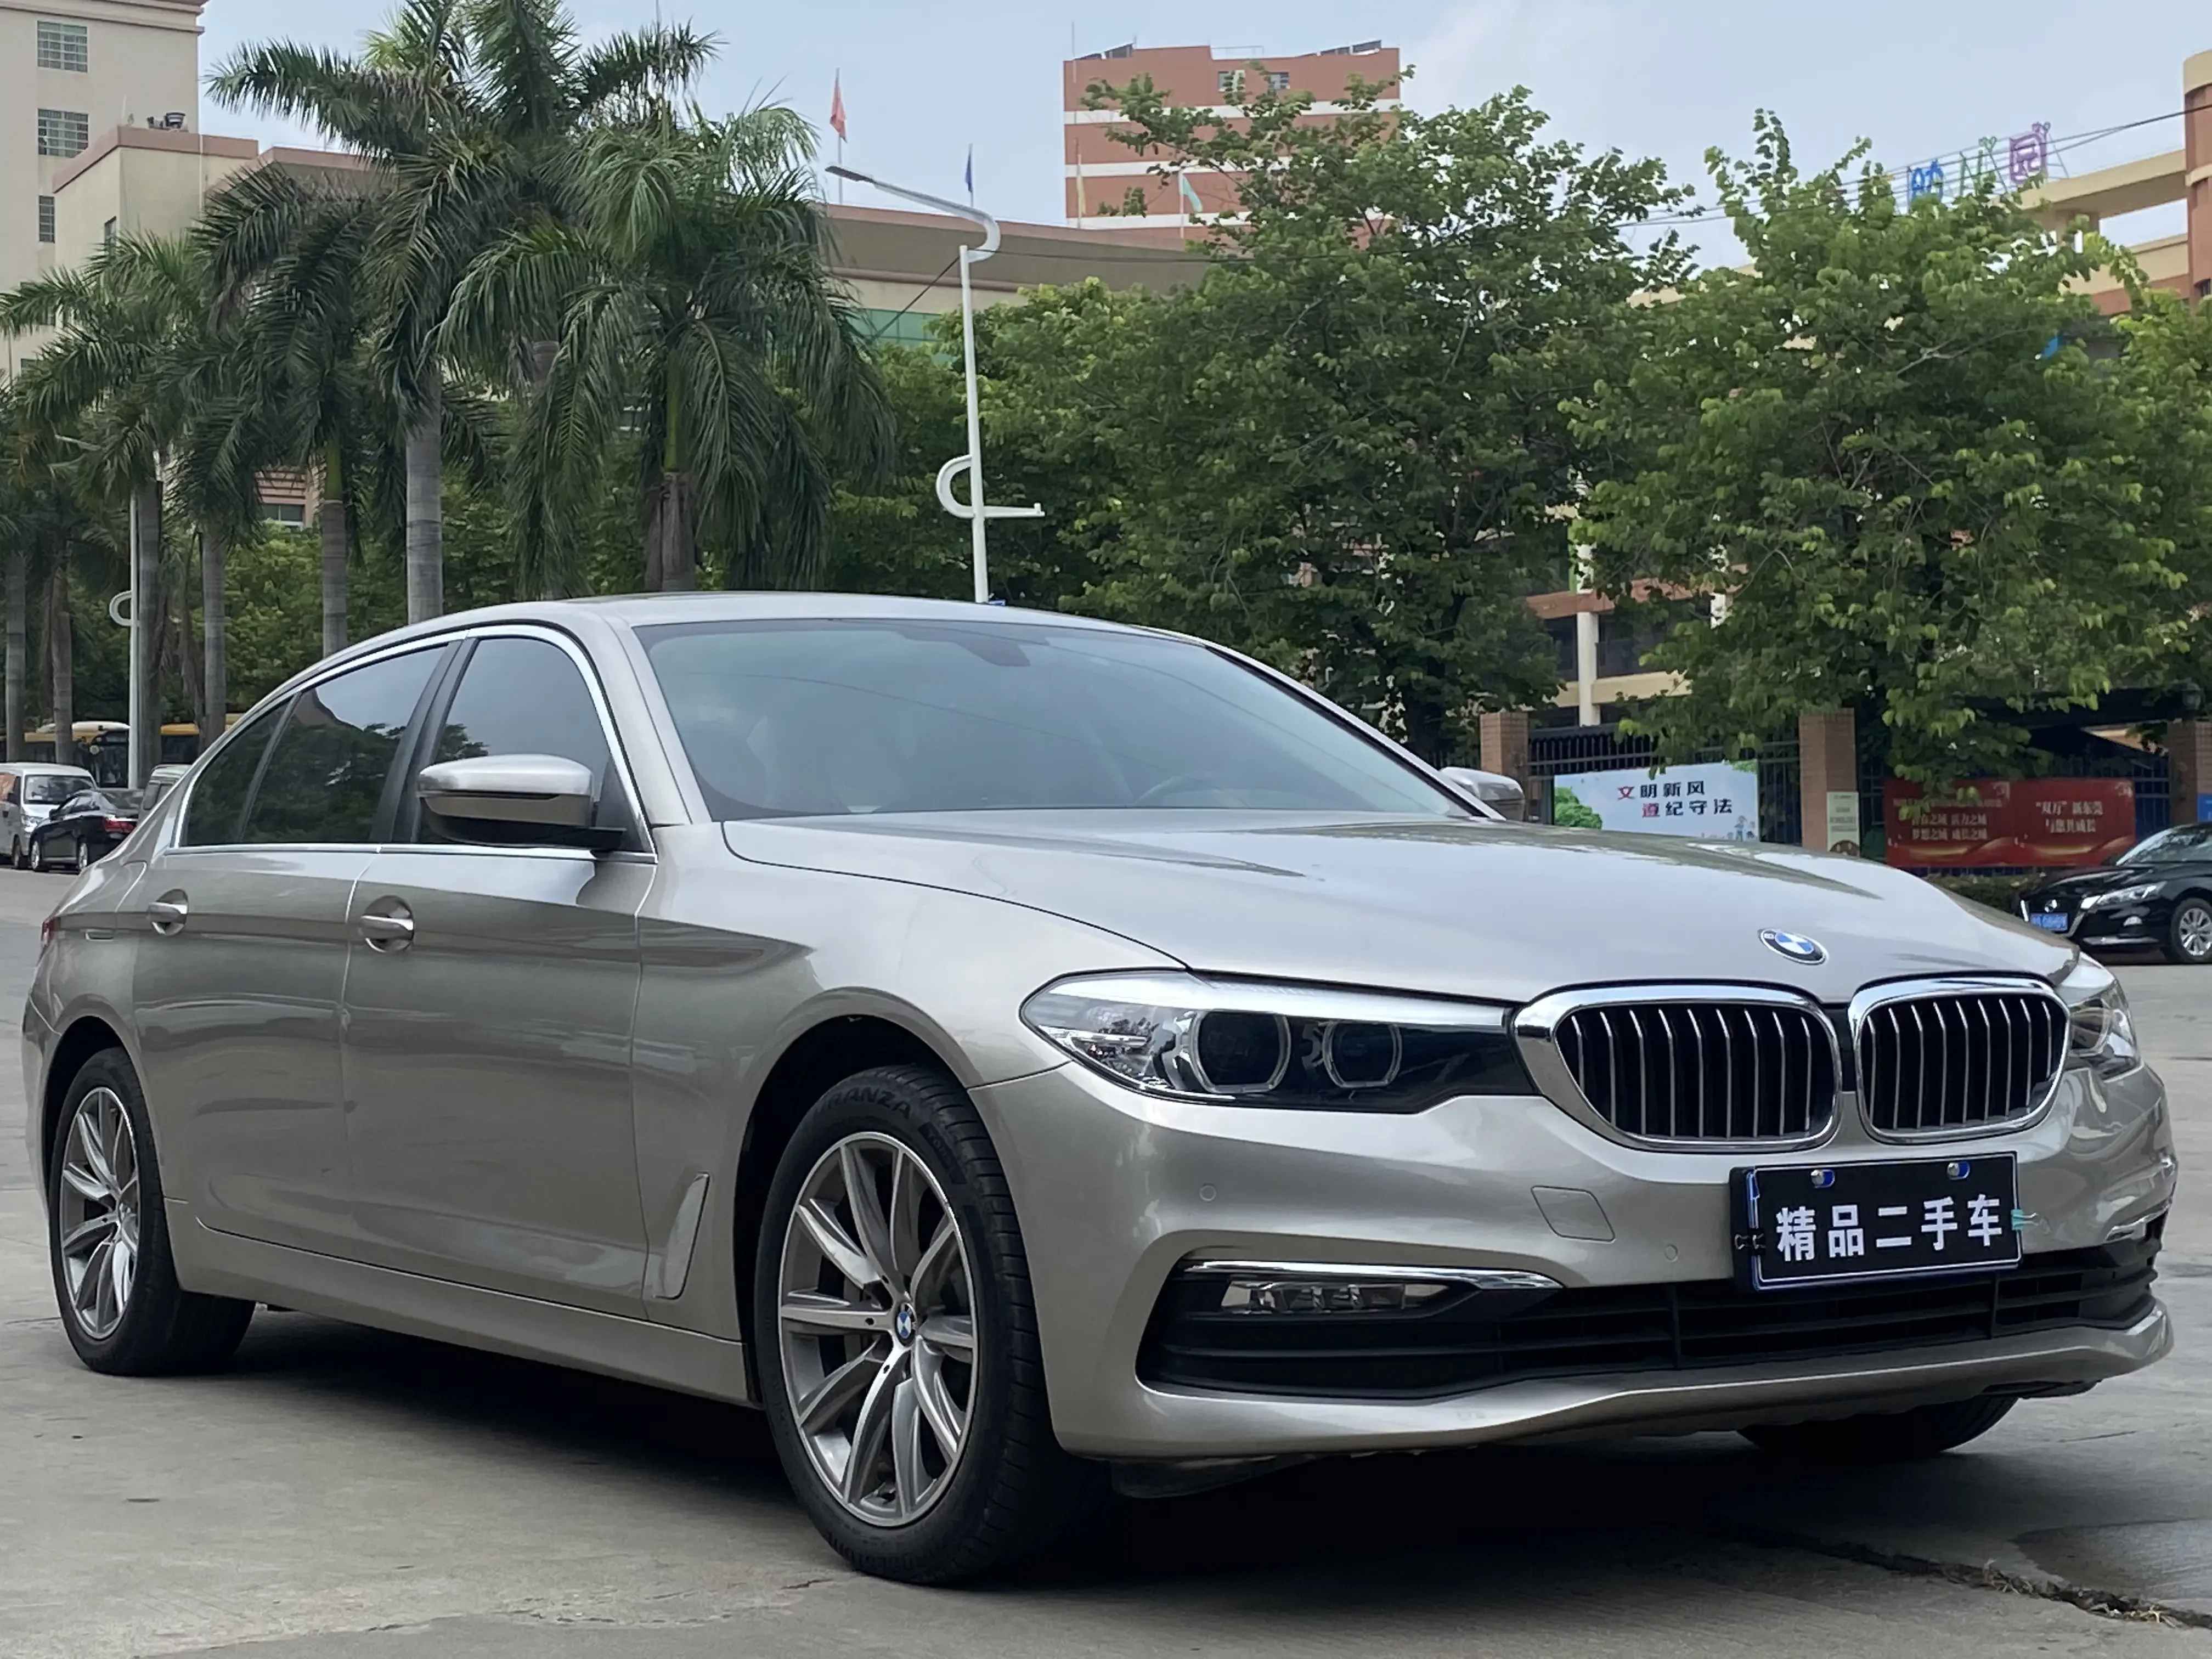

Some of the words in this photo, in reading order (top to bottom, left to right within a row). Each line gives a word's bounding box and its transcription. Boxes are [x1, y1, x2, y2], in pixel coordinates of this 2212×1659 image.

[1618, 781, 1705, 800] 文明新风
[1642, 799, 1733, 817] 遵纪守法
[1775, 1193, 2002, 1262] 精品二手车
